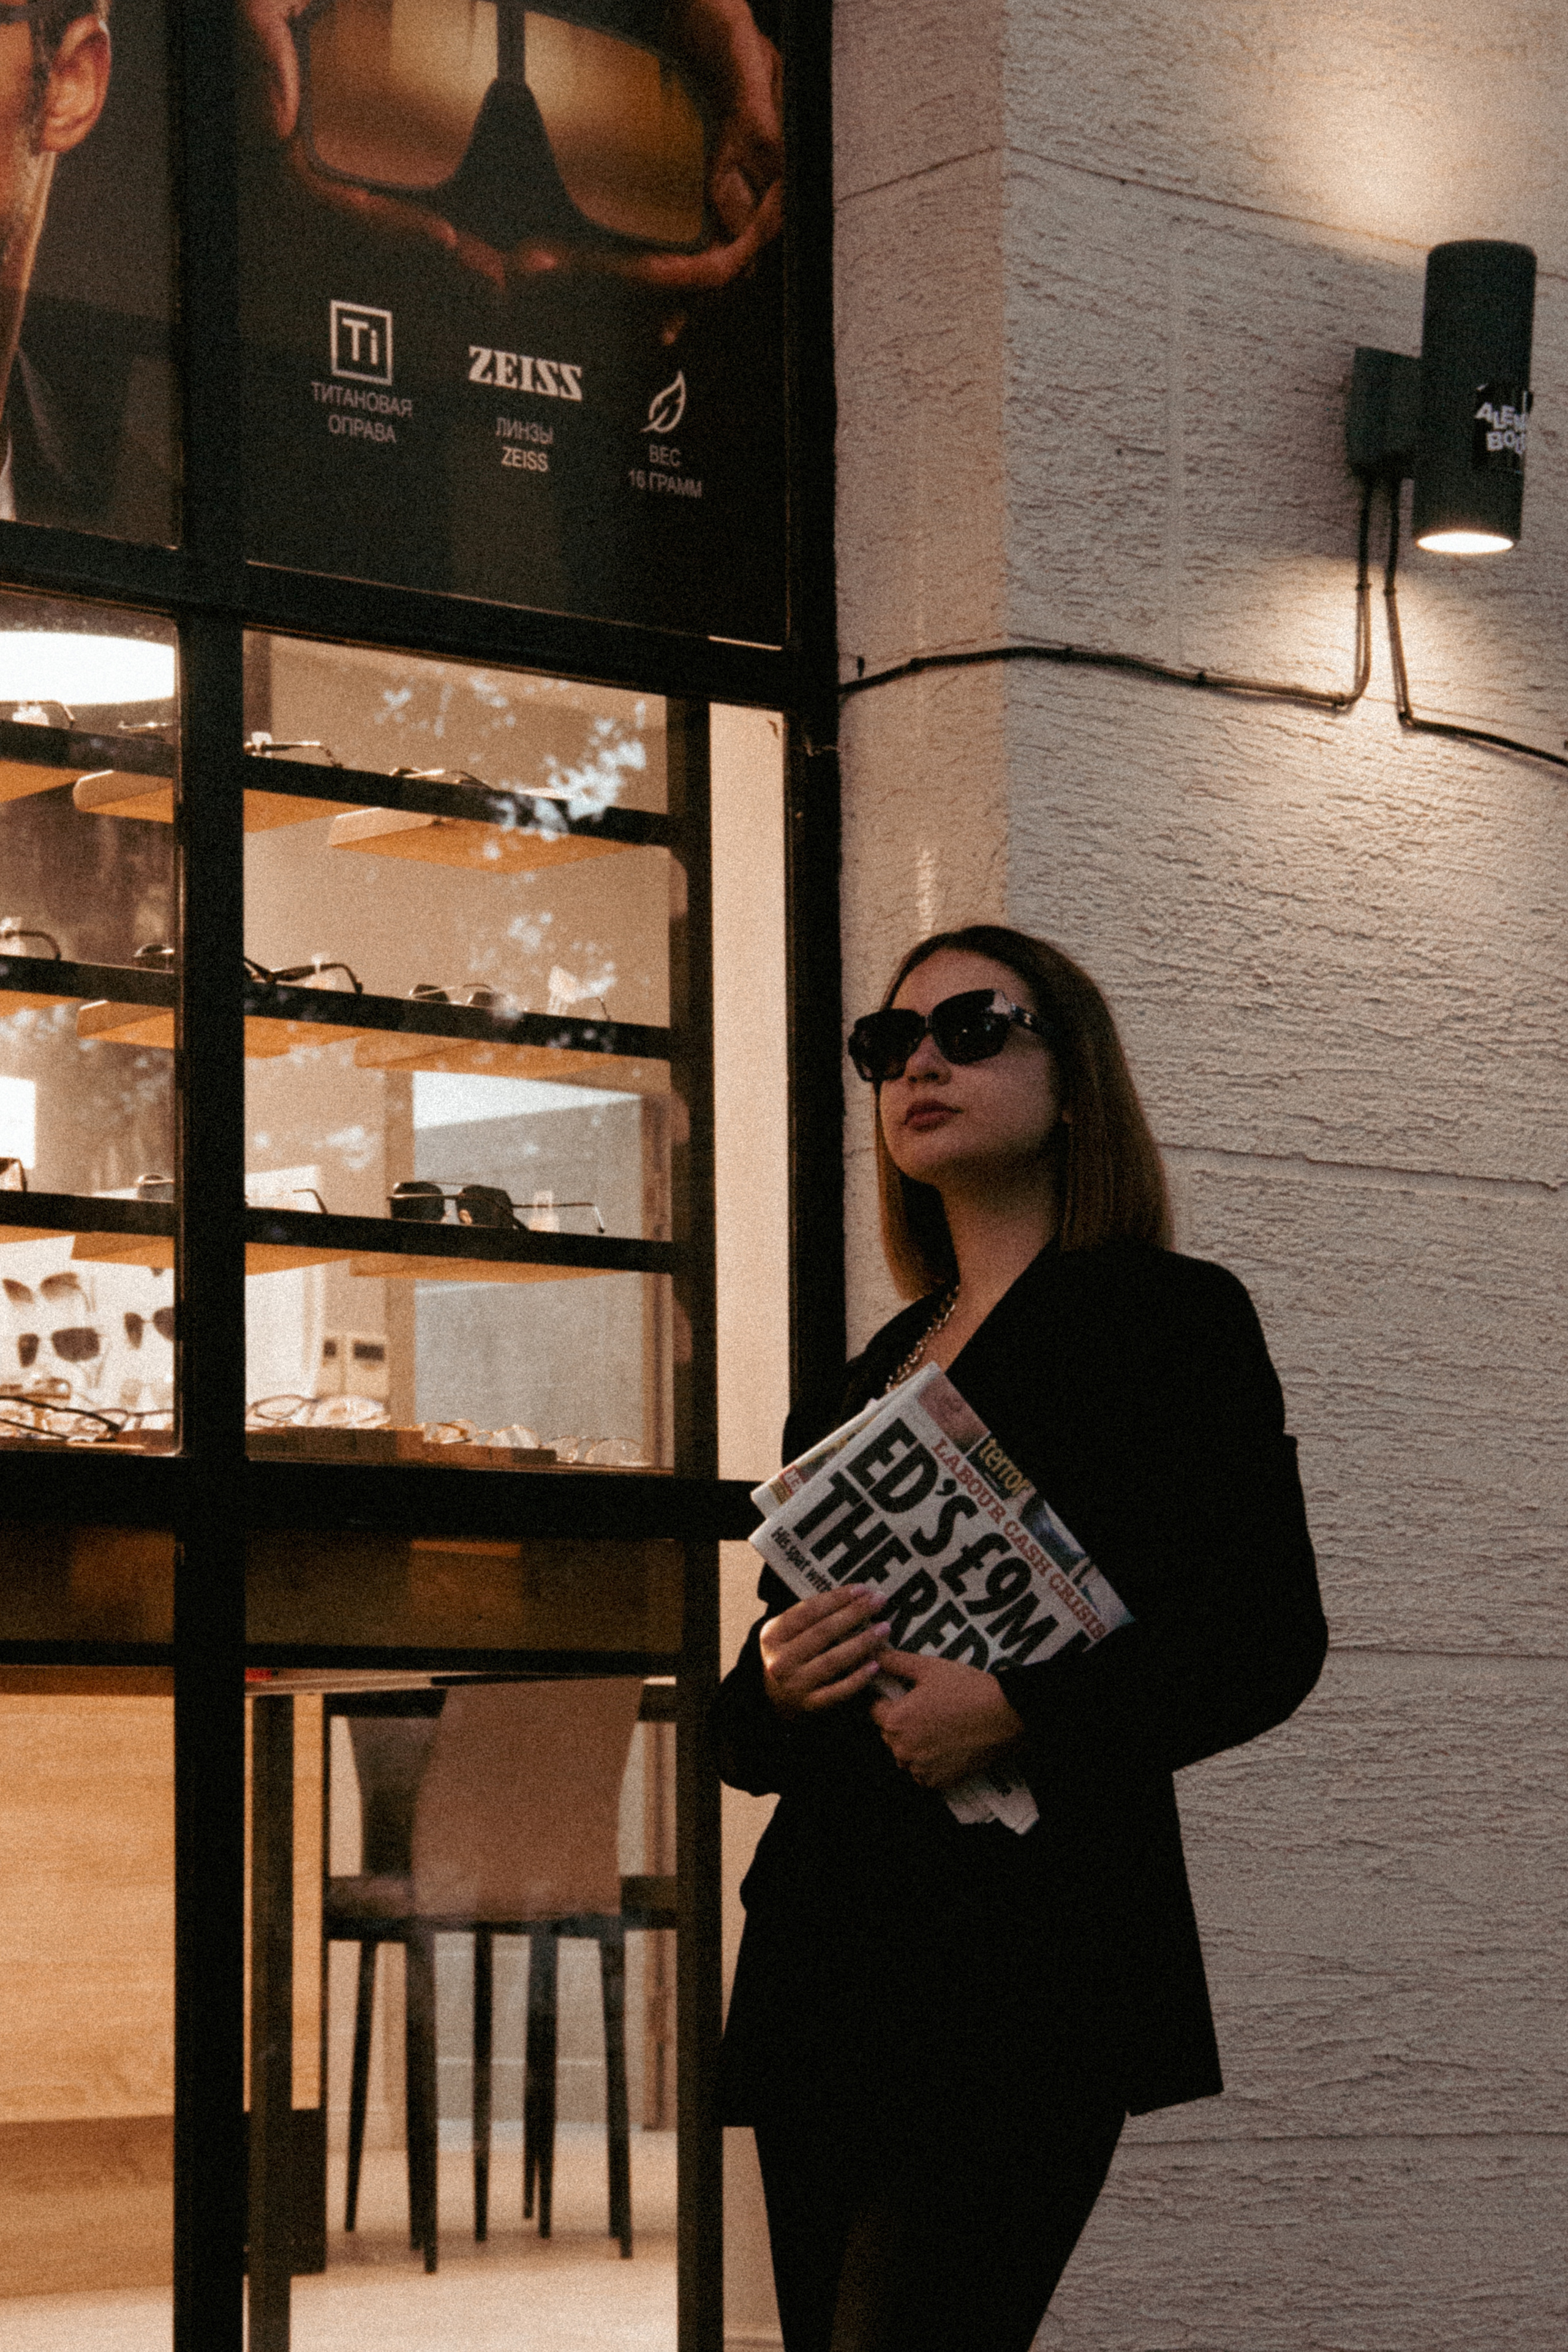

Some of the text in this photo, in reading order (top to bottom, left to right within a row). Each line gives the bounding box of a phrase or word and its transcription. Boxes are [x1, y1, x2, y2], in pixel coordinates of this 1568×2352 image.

[342, 318, 378, 365] Ti
[468, 345, 582, 401] ZEISS
[311, 382, 413, 418] ТИТАНОВАЯ
[328, 414, 396, 443] ОПРАВА
[496, 417, 552, 445] ЛИНЗЫ
[501, 447, 548, 472] ZEISS
[649, 444, 680, 467] ВЕС
[628, 469, 703, 499] 16 ГРАММ
[977, 1438, 1033, 1496] terror
[771, 1526, 792, 1550] His
[784, 1544, 811, 1572] spat
[794, 1471, 912, 1585] THE
[845, 1417, 1060, 1664] ED'S £9M
[930, 1438, 1106, 1640] LABOUR CASH CRISIS
